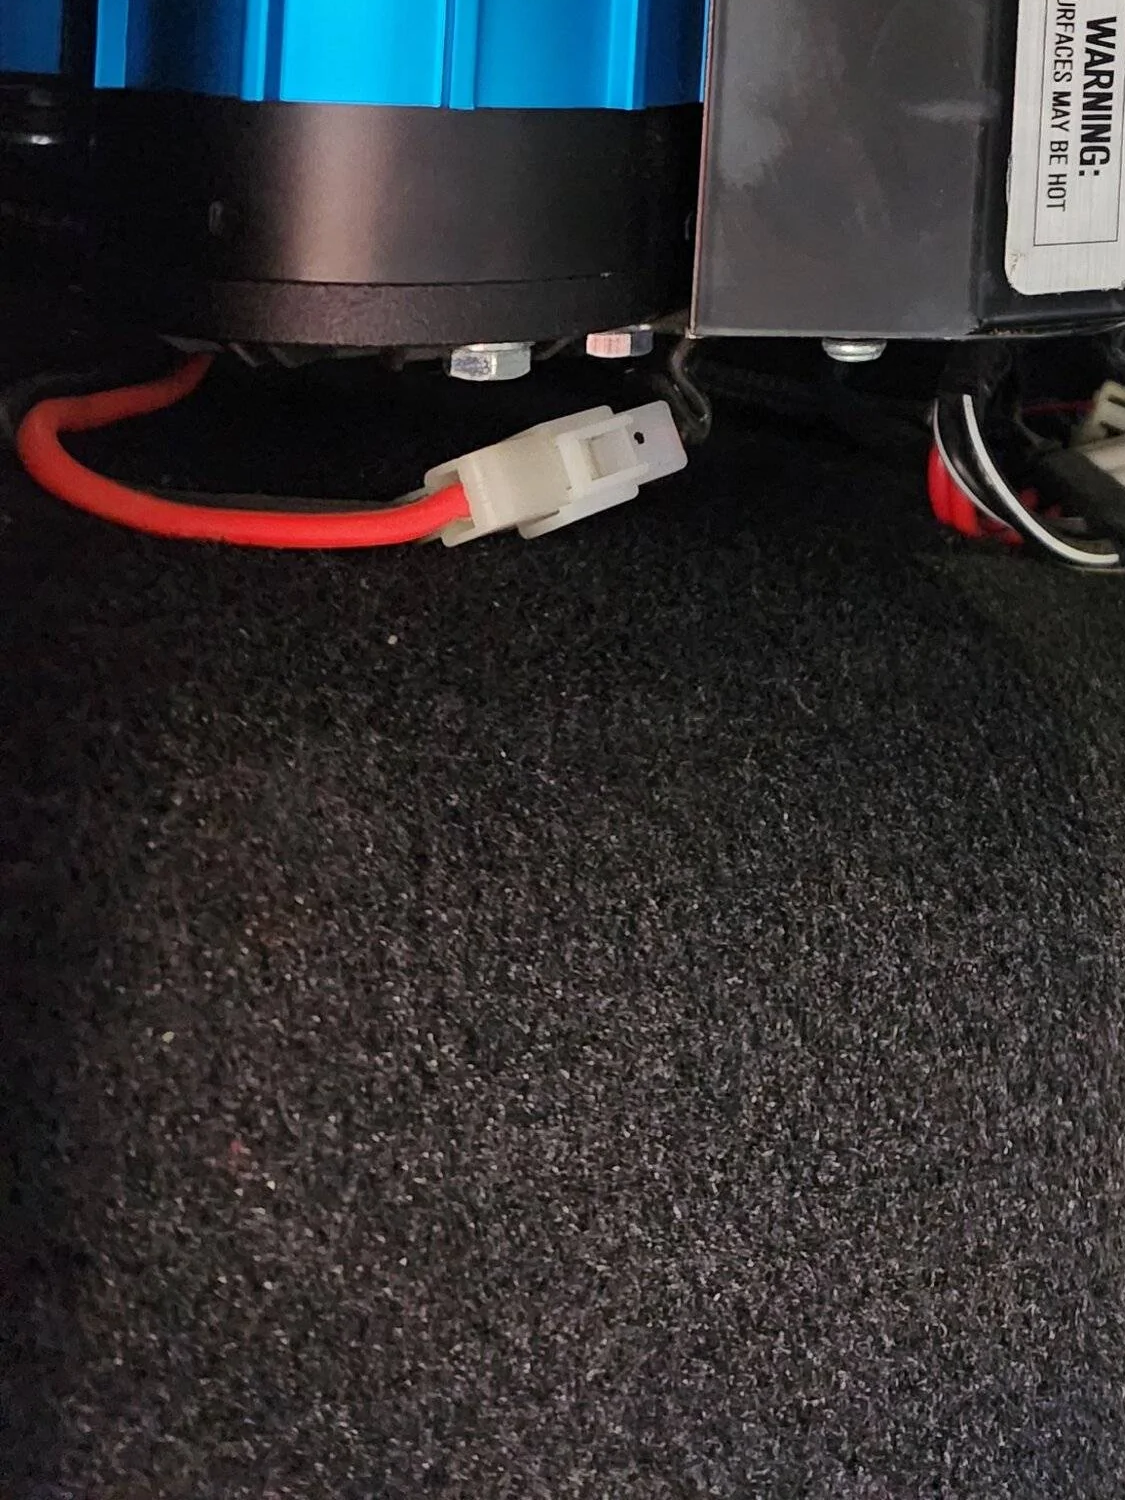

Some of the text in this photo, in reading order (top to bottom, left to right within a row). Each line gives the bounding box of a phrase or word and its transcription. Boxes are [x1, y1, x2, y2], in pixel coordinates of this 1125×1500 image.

[1051, 90, 1072, 133] MAY
[1078, 15, 1118, 177] WARNING:
[1048, 139, 1070, 166] BE
[1046, 172, 1068, 213] HOT
